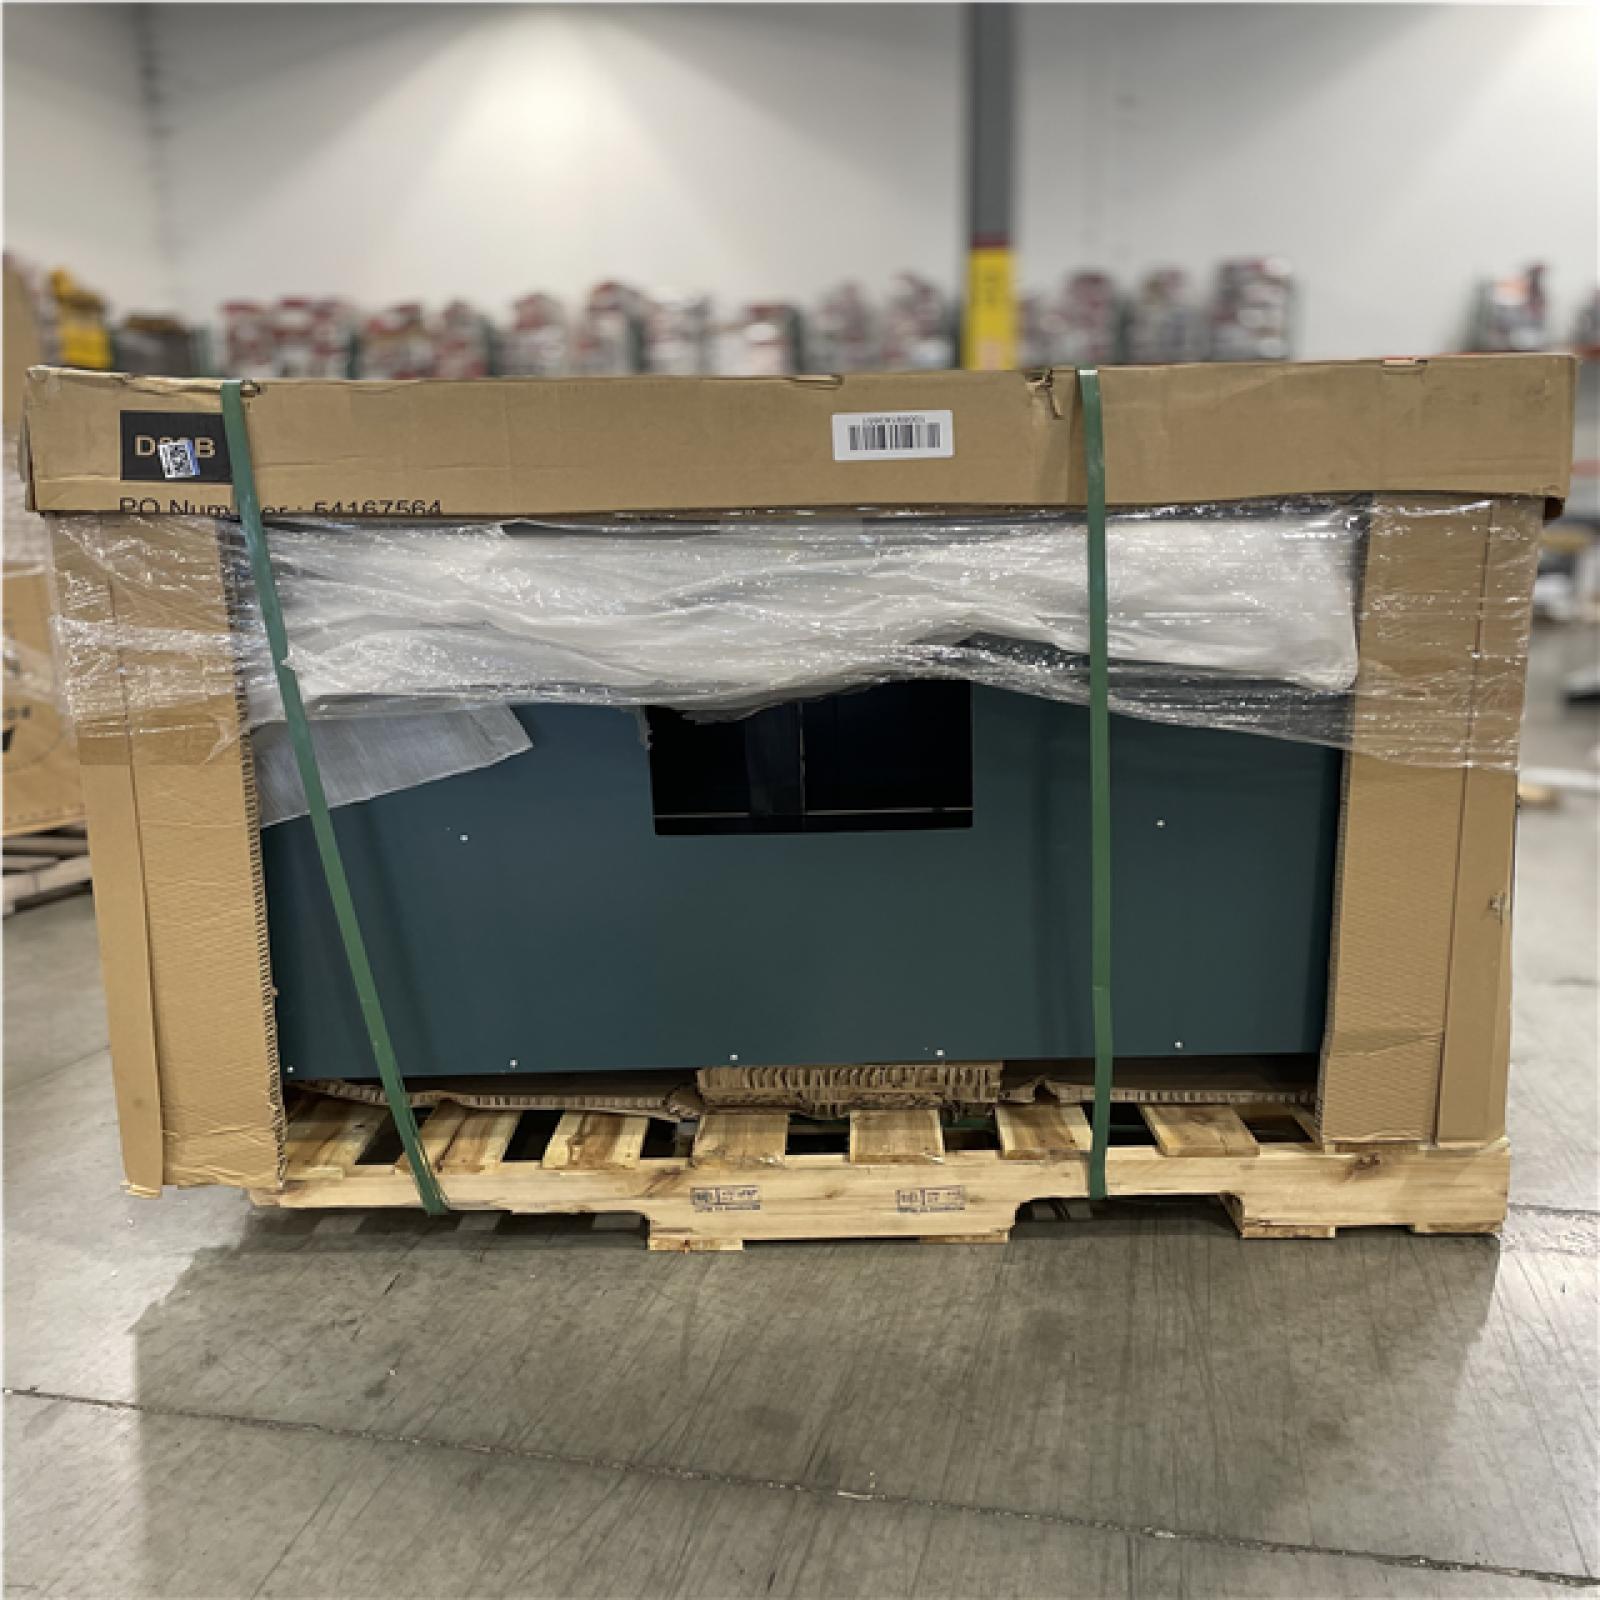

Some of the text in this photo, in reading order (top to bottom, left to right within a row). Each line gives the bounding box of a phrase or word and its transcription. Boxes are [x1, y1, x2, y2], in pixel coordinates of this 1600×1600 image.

[135, 435, 215, 458] DB
[120, 497, 160, 513] PO
[170, 500, 288, 514] Numer
